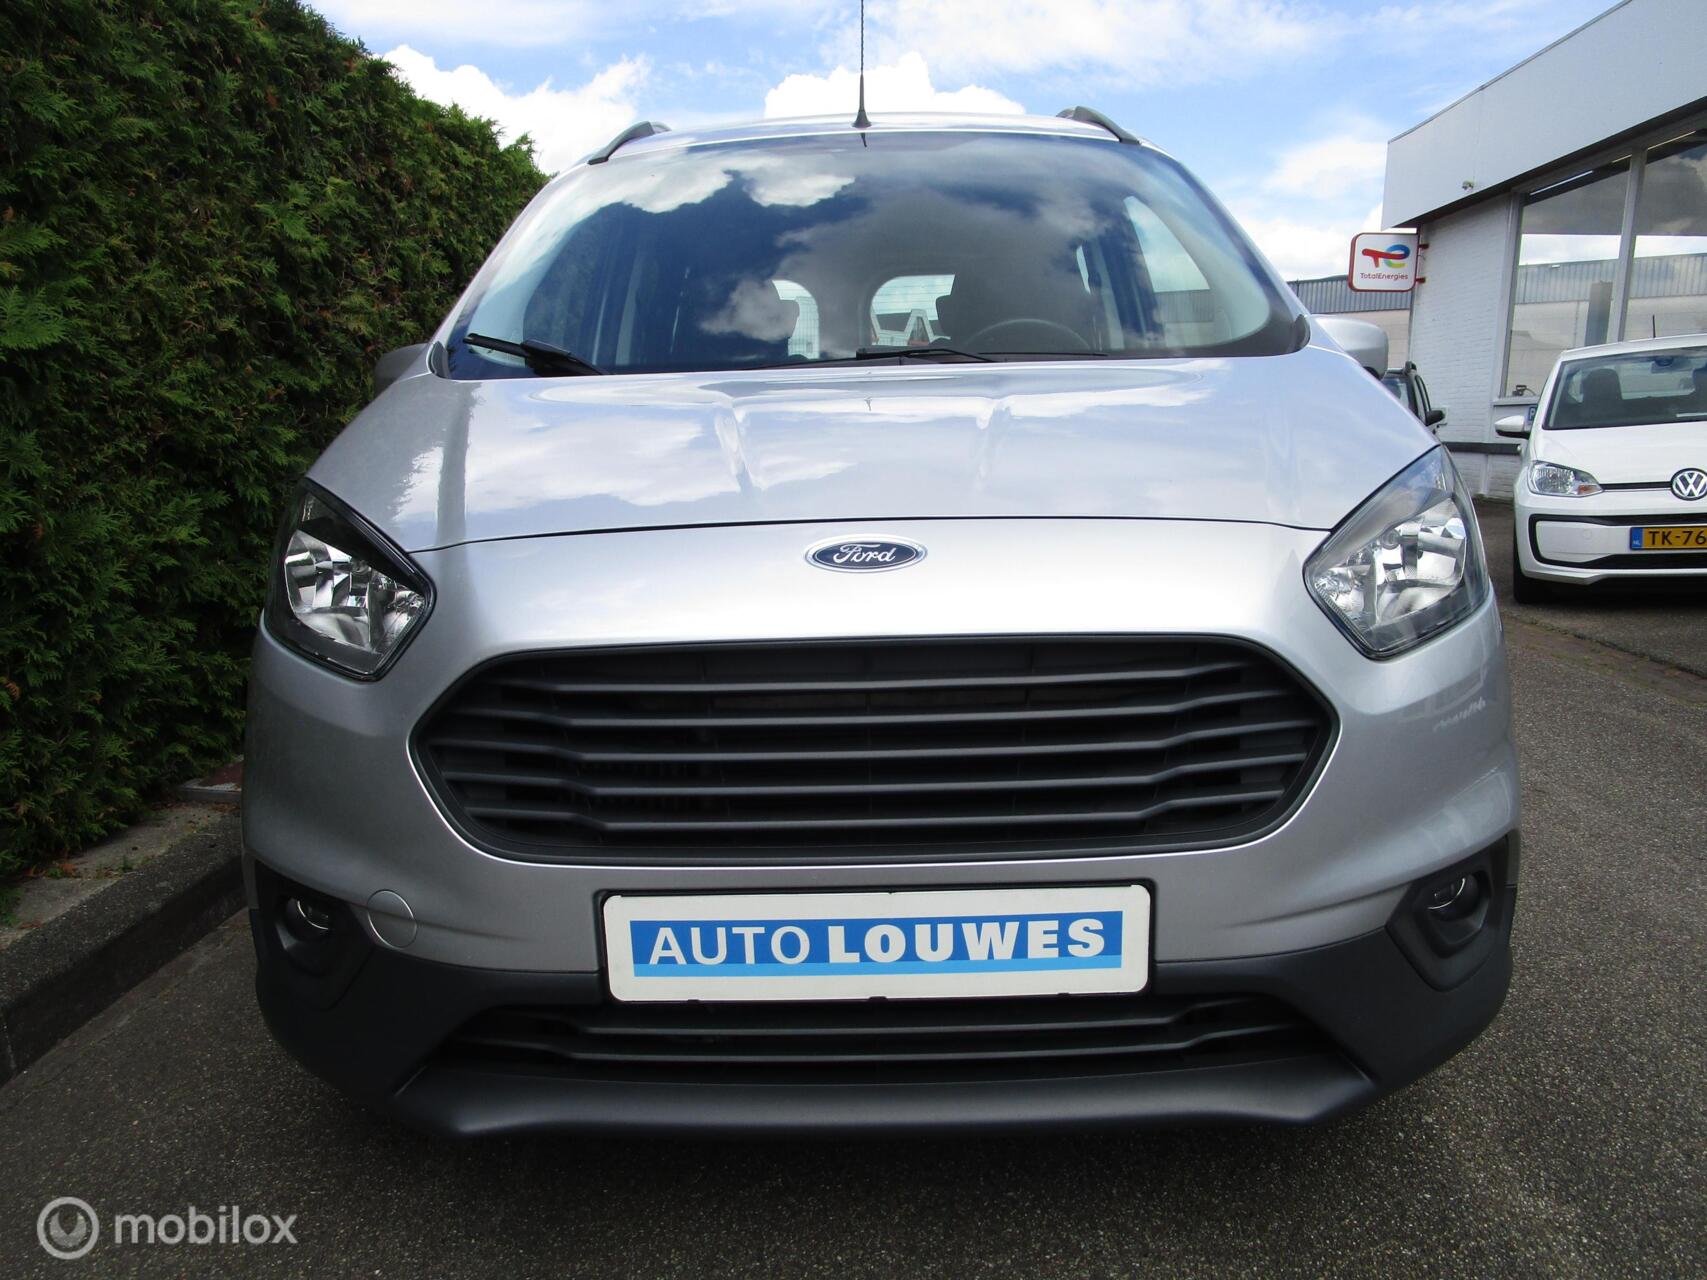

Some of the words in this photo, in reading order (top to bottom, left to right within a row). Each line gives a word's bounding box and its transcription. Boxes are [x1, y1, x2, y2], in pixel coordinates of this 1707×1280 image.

[1360, 272, 1409, 281] TotalEnergies
[1648, 530, 1707, 546] TK-76
[833, 544, 897, 563] Ford
[648, 924, 811, 966] AUTO
[827, 918, 1106, 964] LOUWES
